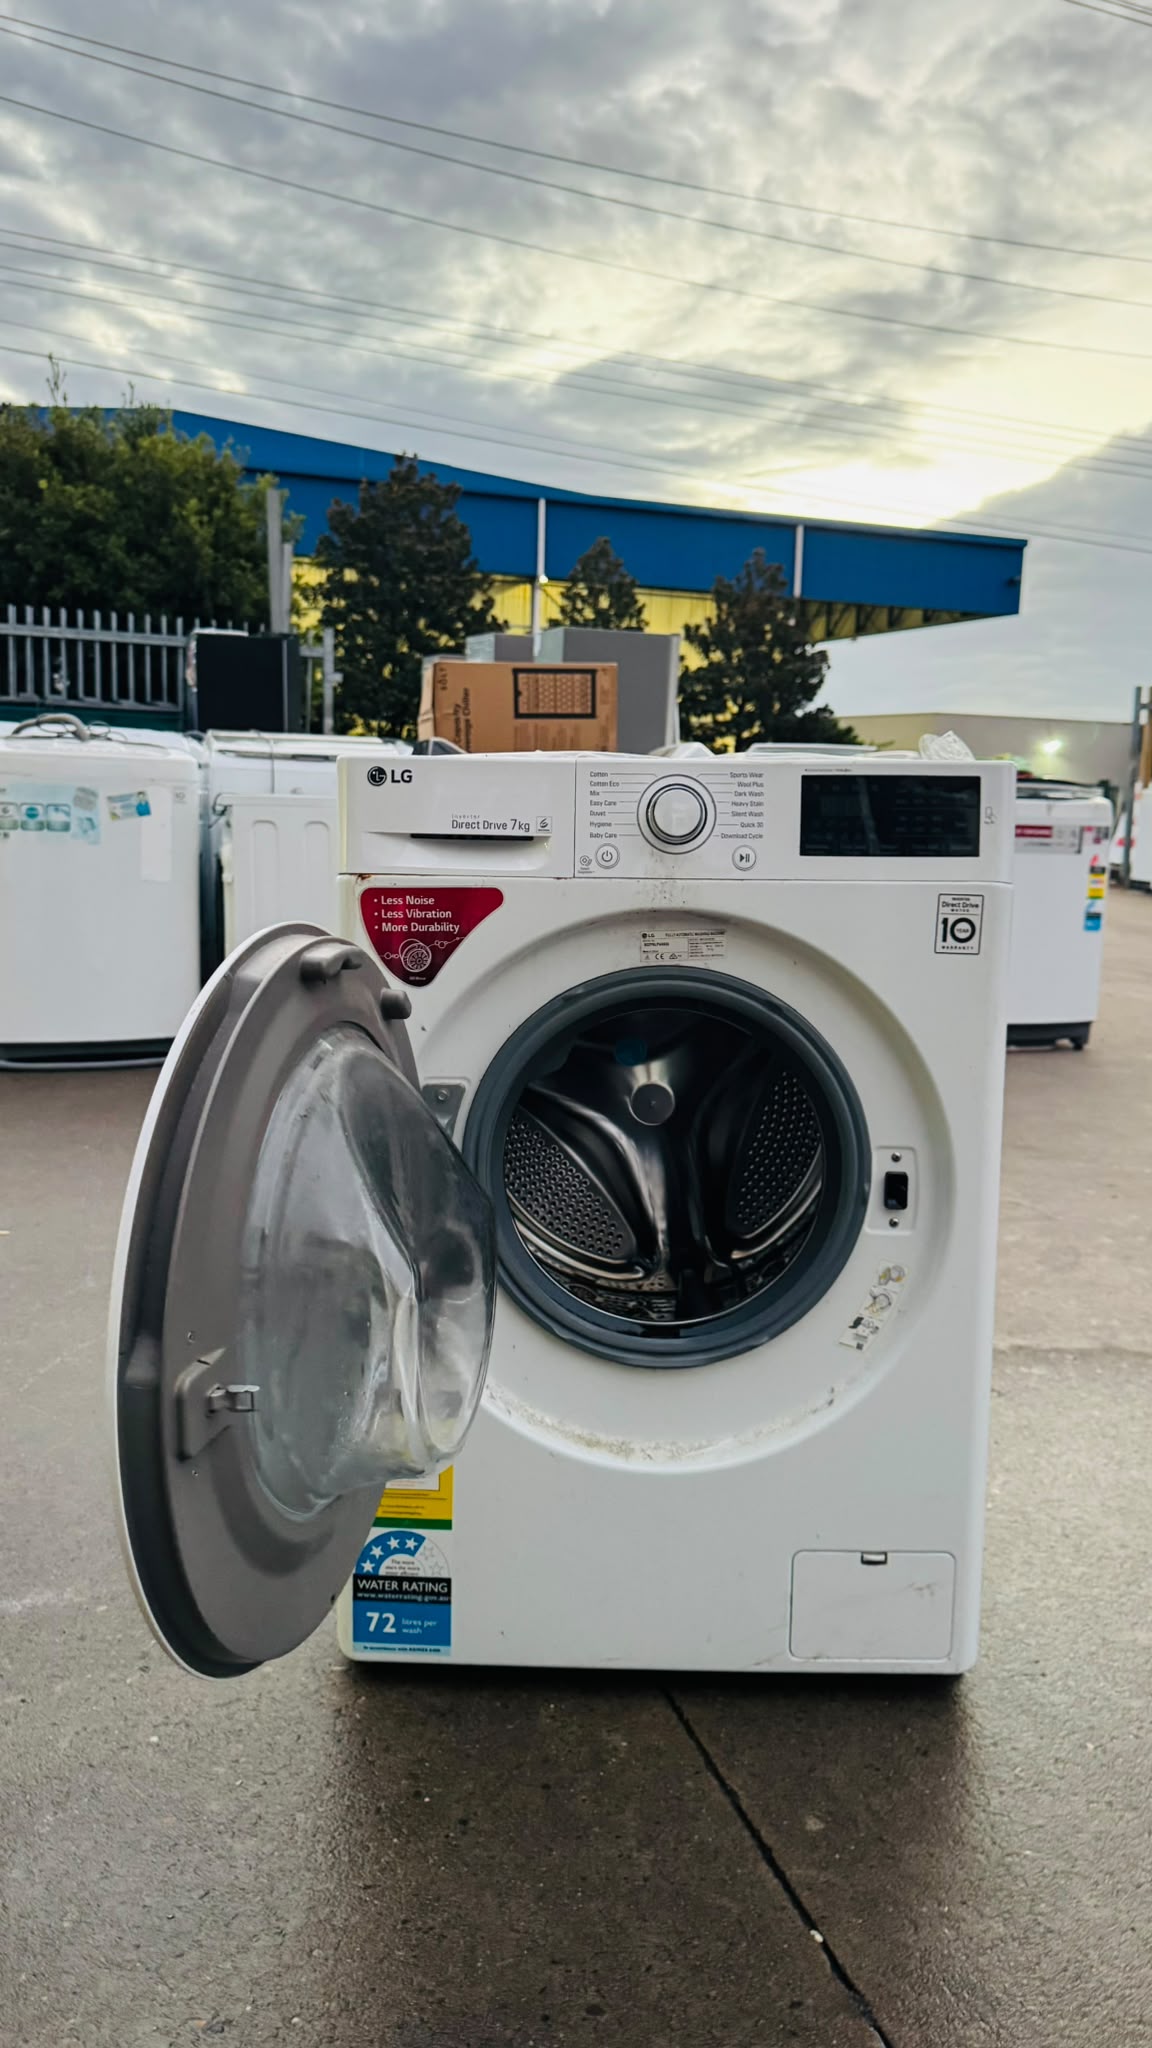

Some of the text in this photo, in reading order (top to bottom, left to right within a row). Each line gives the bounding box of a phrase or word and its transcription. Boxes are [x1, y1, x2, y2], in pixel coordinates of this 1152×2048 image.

[391, 769, 413, 784] LG
[452, 819, 480, 830] Direct
[482, 820, 508, 830] Drive
[381, 896, 435, 905] Less Noise
[381, 909, 452, 918] Less Vibration
[382, 922, 460, 934] More Durability
[941, 917, 976, 944] 10
[357, 1579, 448, 1593] WATER RATING
[366, 1612, 438, 1633] 72 litres per
[402, 1626, 422, 1634] wash
